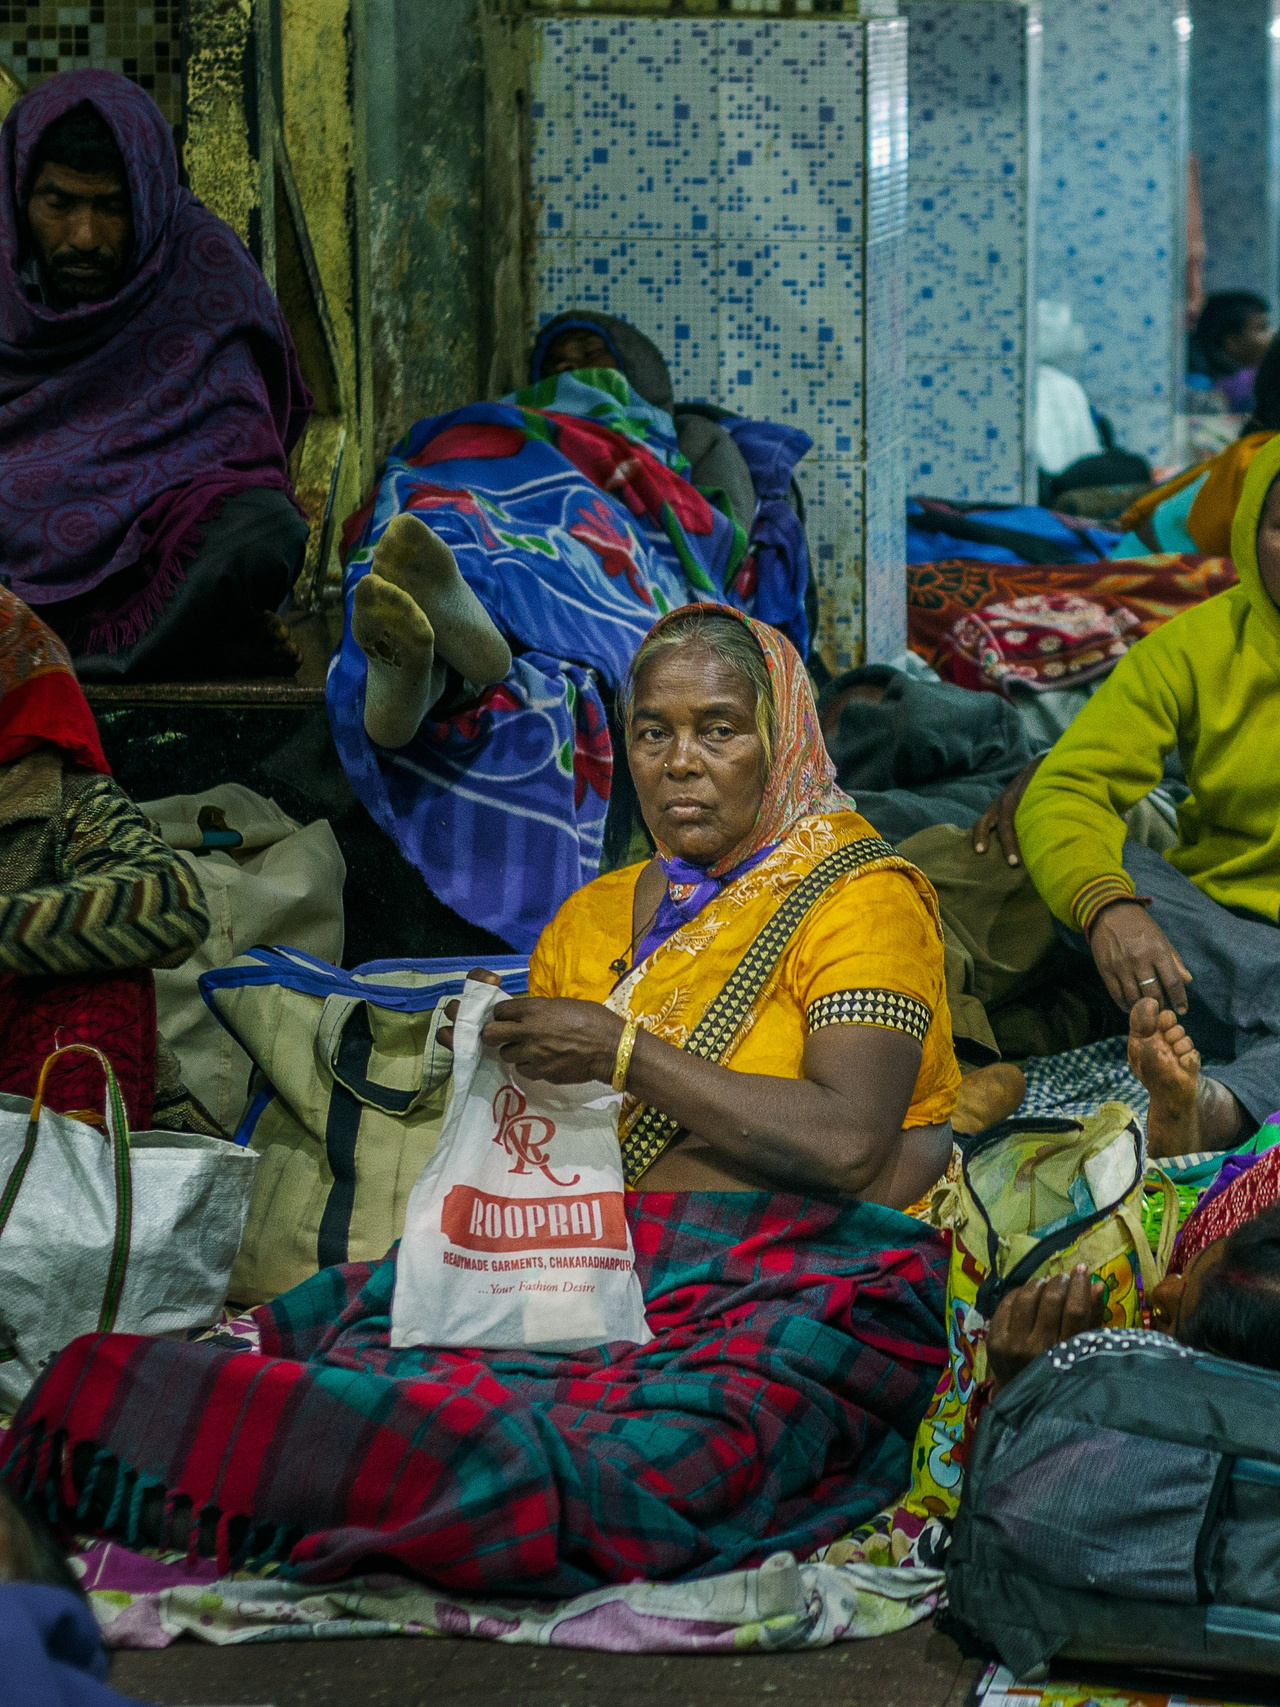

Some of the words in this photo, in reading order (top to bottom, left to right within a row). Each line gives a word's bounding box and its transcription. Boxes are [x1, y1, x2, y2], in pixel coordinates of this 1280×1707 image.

[469, 1197, 603, 1241] ROOPRAJ
[443, 1251, 489, 1272] READYMADE
[491, 1255, 547, 1273] GARMENTS,
[550, 1255, 632, 1273] CHAKARADHARPUR
[518, 1280, 558, 1293] Fashion
[562, 1281, 596, 1293] Desire
